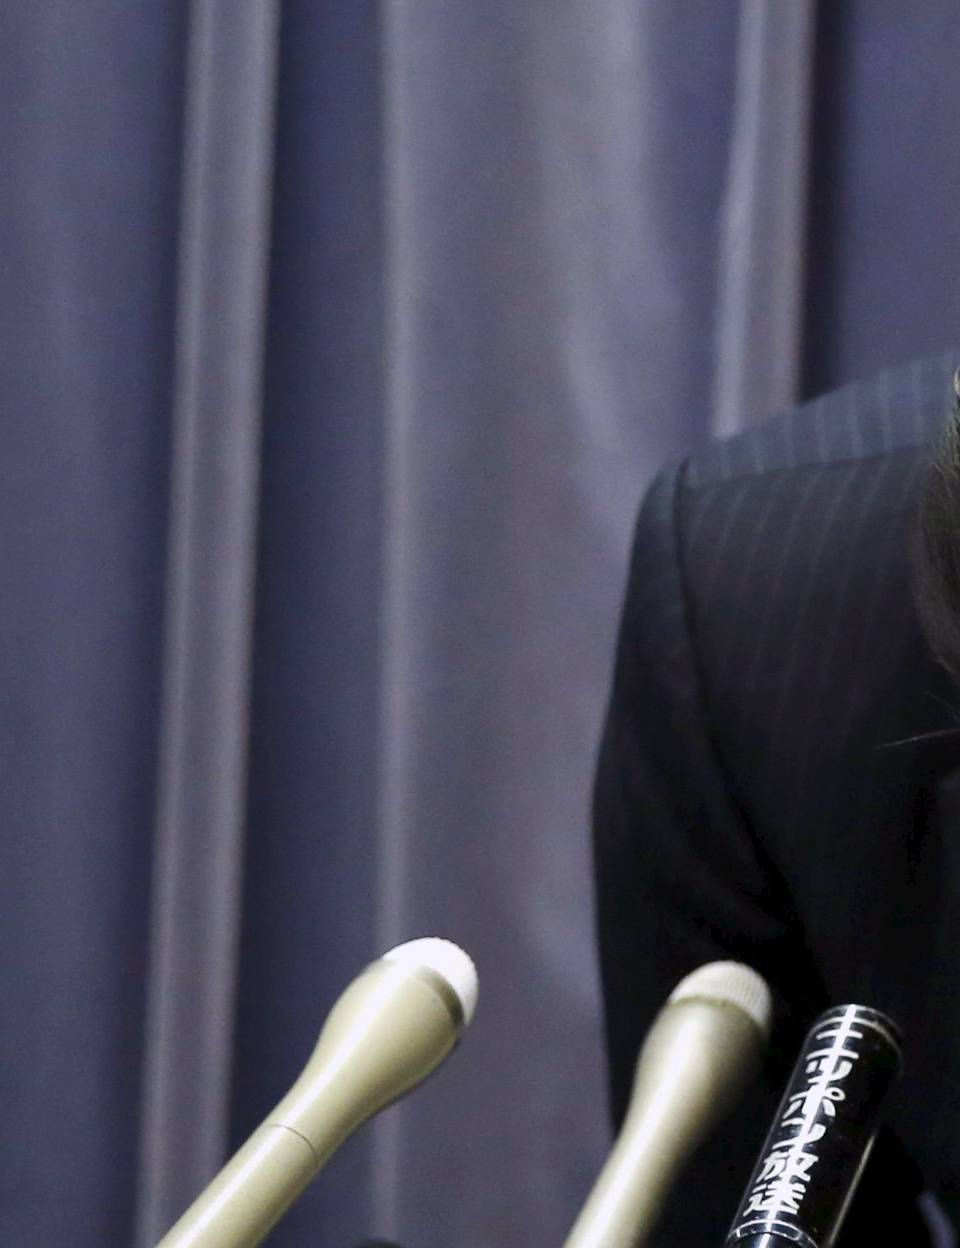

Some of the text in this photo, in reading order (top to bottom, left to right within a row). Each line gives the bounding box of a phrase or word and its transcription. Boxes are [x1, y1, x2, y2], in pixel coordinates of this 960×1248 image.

[743, 1031, 864, 1216] ニッポン放送
